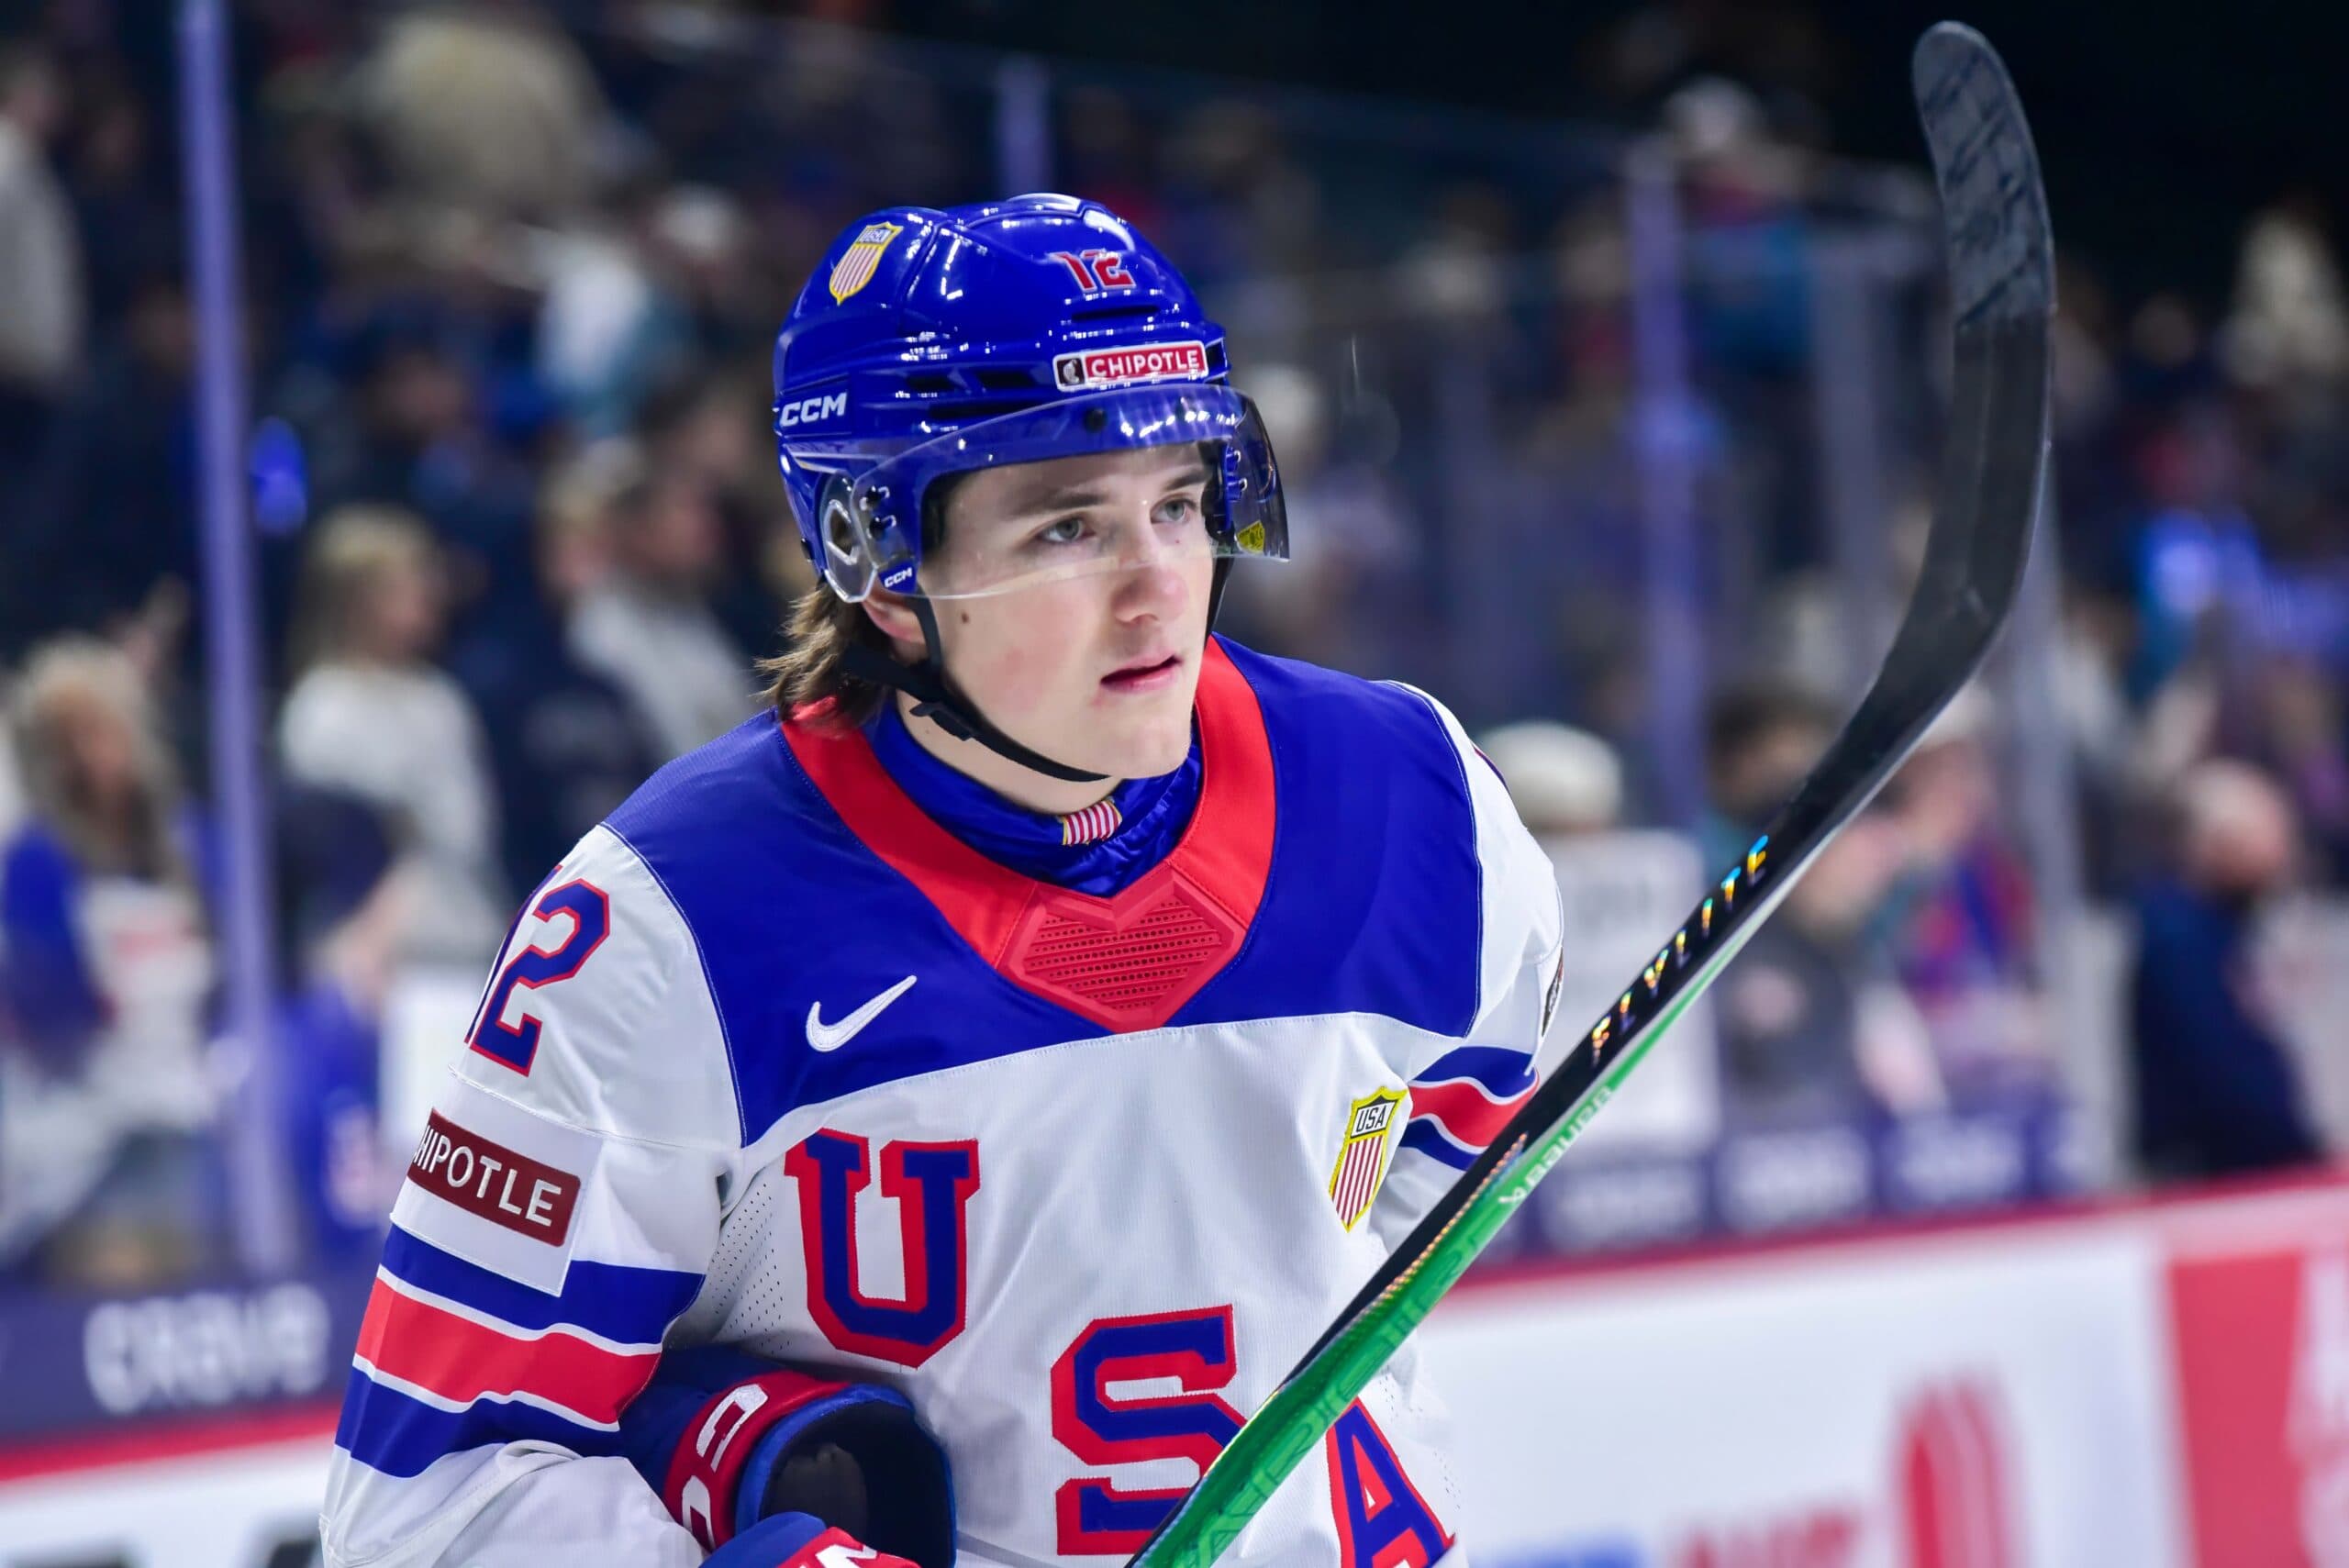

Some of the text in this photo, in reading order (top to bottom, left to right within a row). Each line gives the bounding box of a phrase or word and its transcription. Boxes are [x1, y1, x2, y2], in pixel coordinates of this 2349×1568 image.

[1049, 249, 1136, 292] 12
[1091, 350, 1200, 378] CHIPOTLE
[780, 392, 848, 428] CCM
[884, 567, 913, 589] CCM
[465, 864, 610, 1077] 2
[1355, 1105, 1386, 1133] USA
[414, 1125, 562, 1227] HIPOTLE
